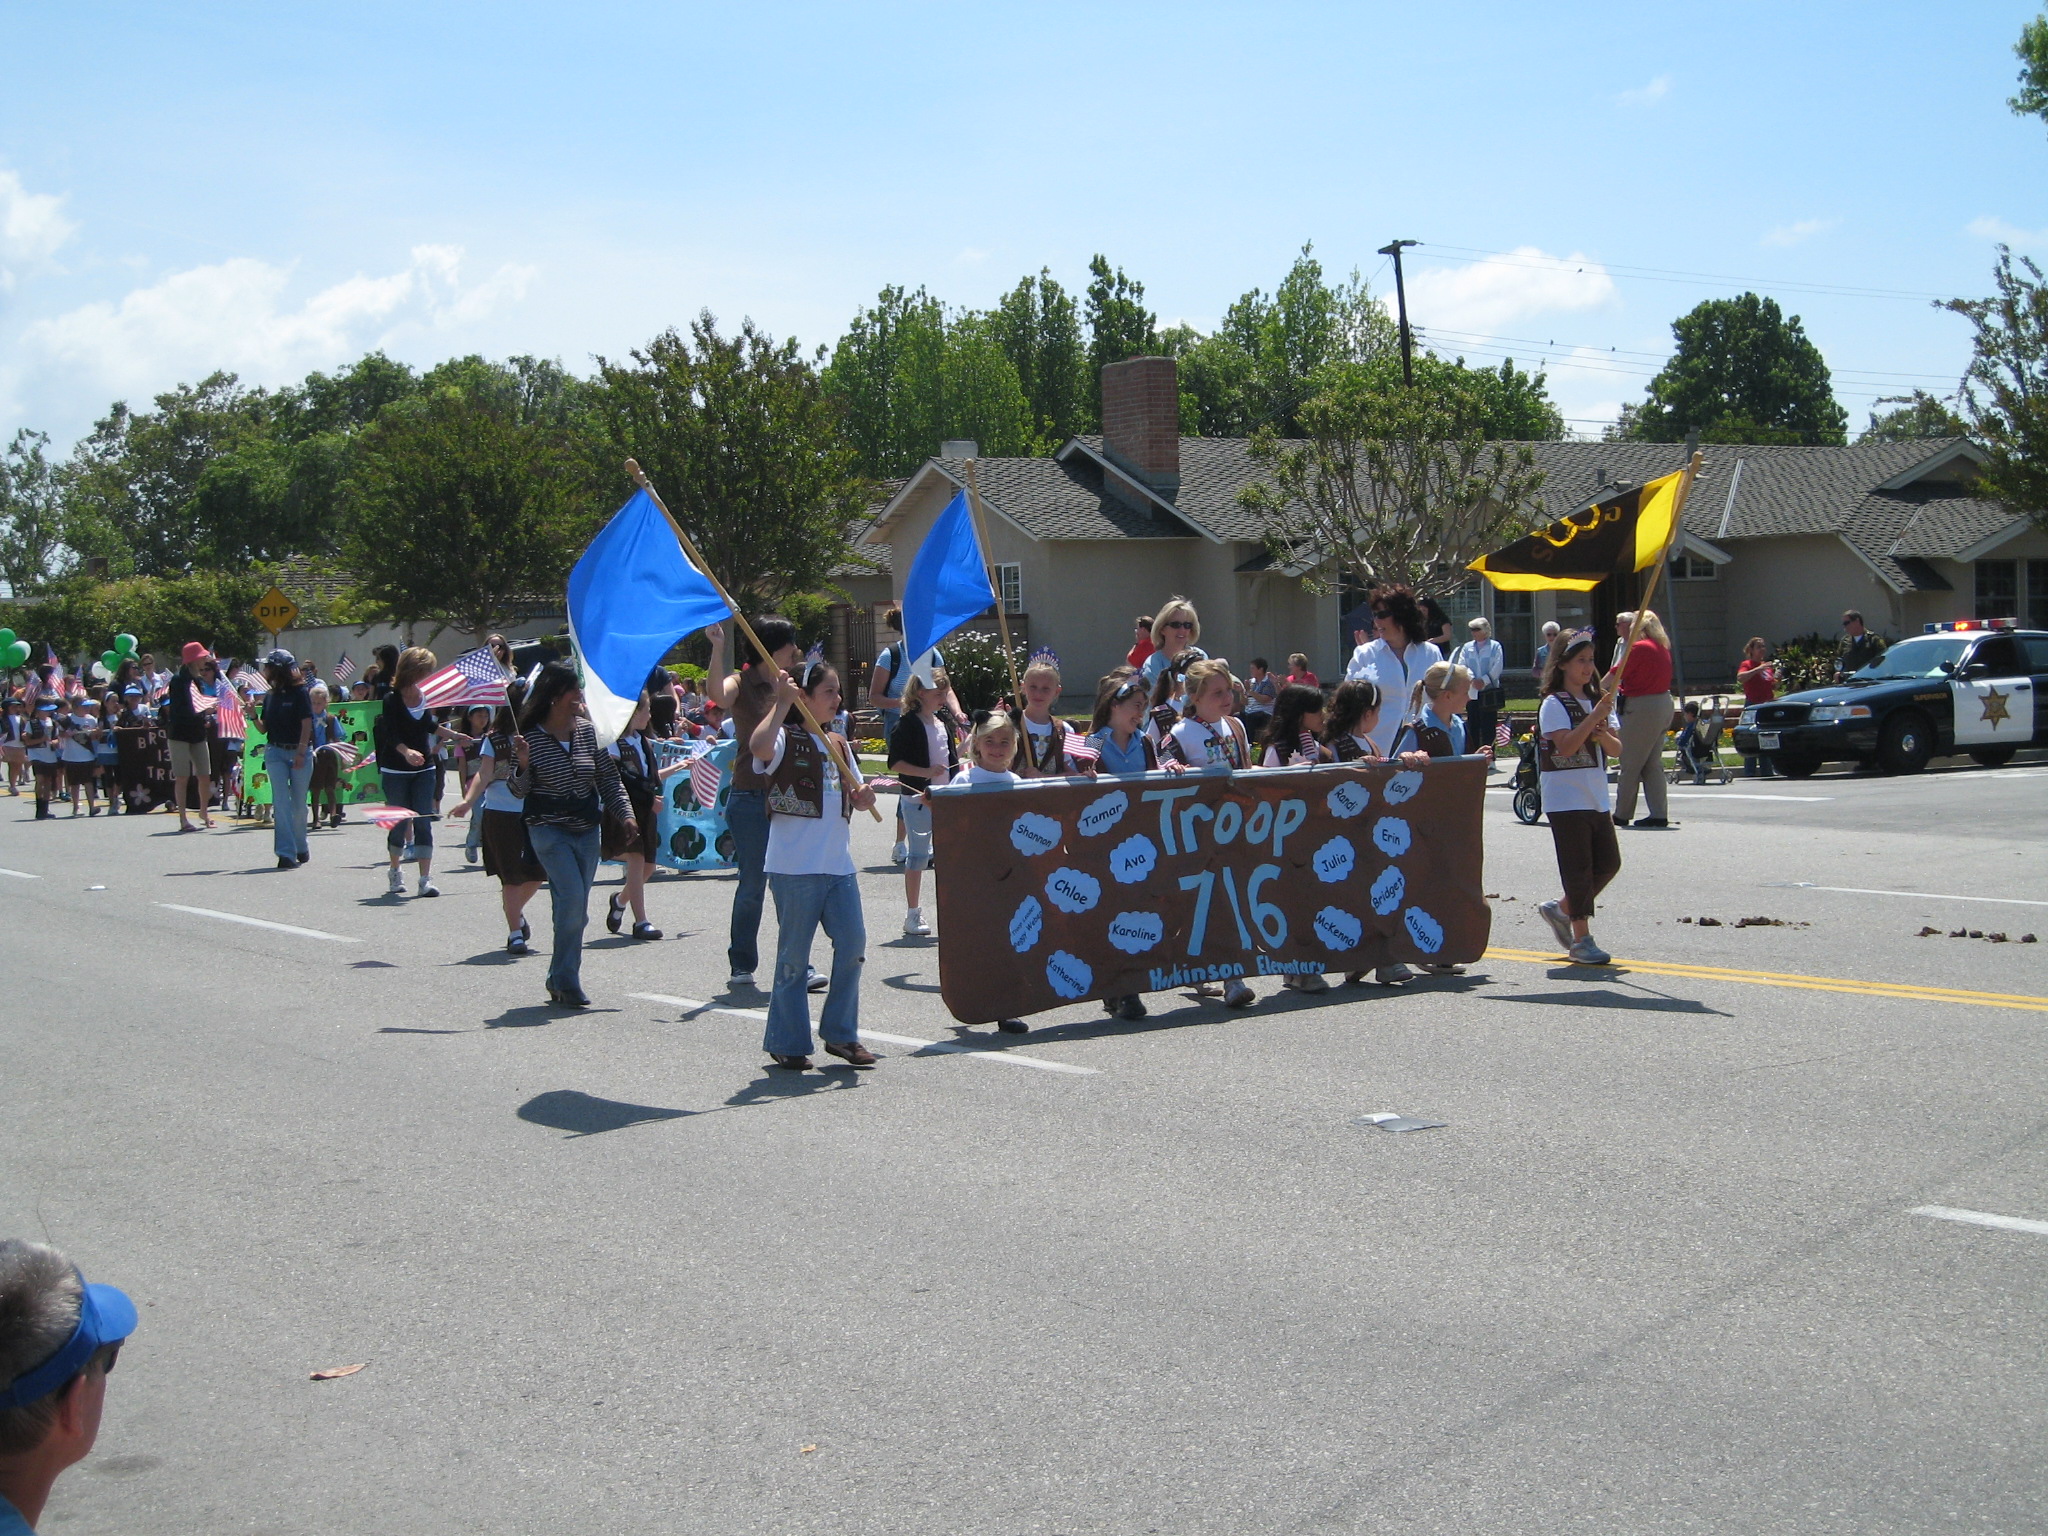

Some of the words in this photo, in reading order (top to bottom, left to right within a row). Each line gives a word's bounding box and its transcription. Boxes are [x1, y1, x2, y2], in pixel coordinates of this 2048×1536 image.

[260, 606, 290, 617] DIP
[796, 743, 810, 753] 716
[1334, 787, 1358, 812] Randi
[1389, 781, 1410, 797] Kacy
[1082, 804, 1122, 827] Tamar
[1141, 785, 1307, 857] Troop
[1016, 824, 1052, 847] Shannon
[1382, 829, 1401, 846] Erin
[1124, 854, 1146, 871] Ava
[1321, 854, 1347, 873] Julia
[1054, 879, 1088, 905] Chloe
[1372, 876, 1404, 909] Bridget
[1177, 863, 1288, 956] 716
[1112, 924, 1156, 941] Karoline
[1315, 914, 1356, 947] McKenna
[1406, 915, 1437, 950] Abigail
[1048, 957, 1086, 993] Katherine
